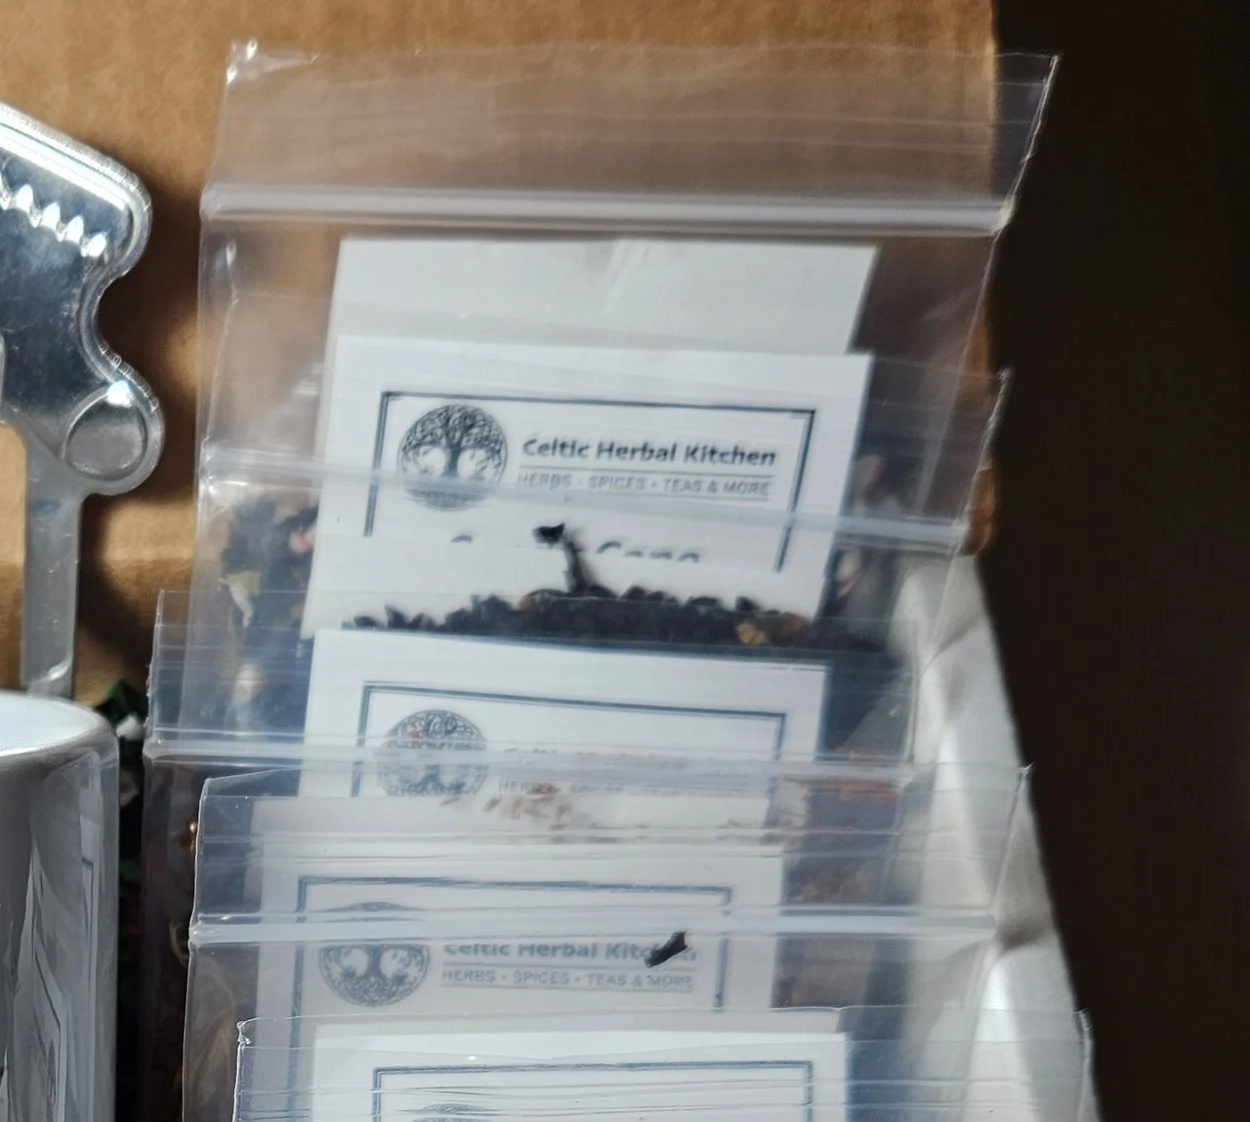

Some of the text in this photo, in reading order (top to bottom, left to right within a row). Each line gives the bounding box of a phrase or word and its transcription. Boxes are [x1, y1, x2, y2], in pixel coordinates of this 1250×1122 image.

[523, 439, 776, 466] Celtic Herbal Kitchen
[518, 474, 571, 487] HERBS
[589, 476, 645, 490] SPICES
[662, 478, 701, 492] TEAS
[723, 481, 771, 494] MORE
[518, 944, 597, 959] Herbal
[442, 970, 496, 982] HERBS
[514, 971, 570, 985] SPICES
[588, 974, 626, 987] TEAS
[649, 975, 694, 988] MORE
